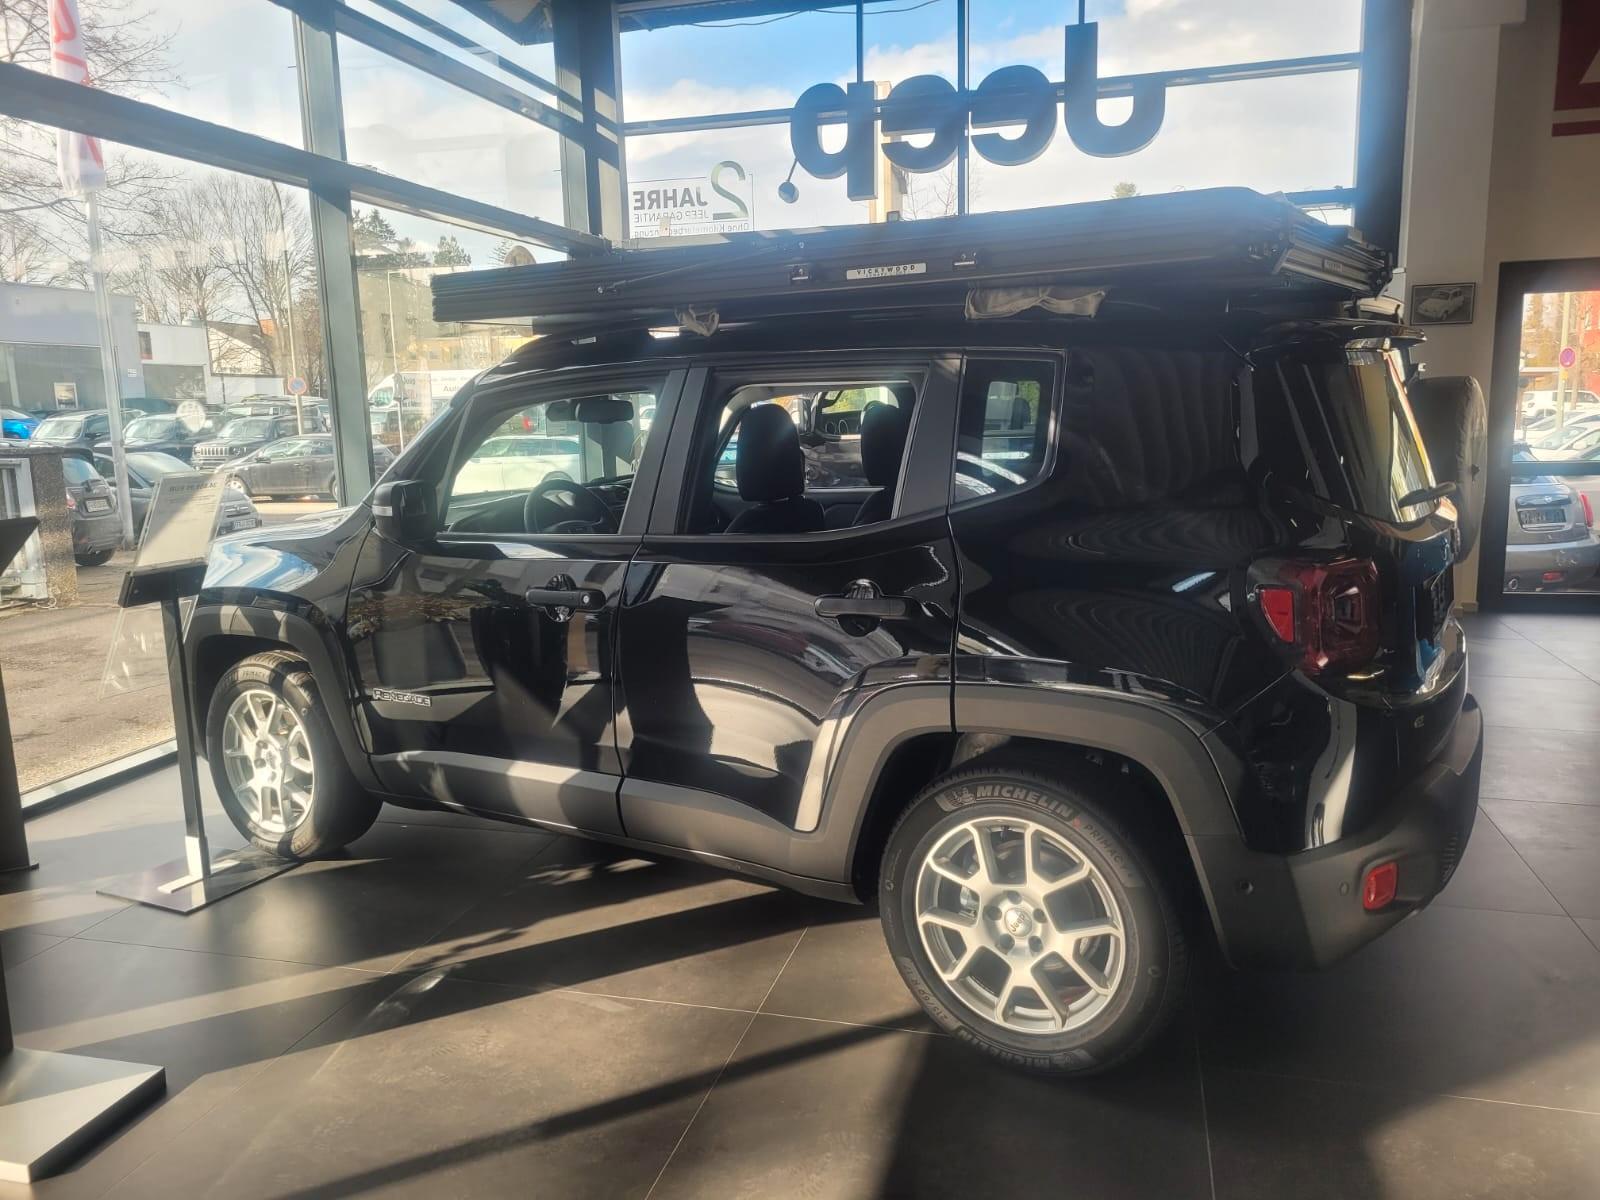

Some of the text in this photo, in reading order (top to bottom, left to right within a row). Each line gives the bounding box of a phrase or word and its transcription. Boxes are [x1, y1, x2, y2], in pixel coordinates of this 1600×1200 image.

[856, 263, 916, 275] VICKYWOOD
[372, 687, 431, 707] RENEGADE
[976, 784, 1074, 819] MICHELIN
[1009, 913, 1025, 932] Jeep
